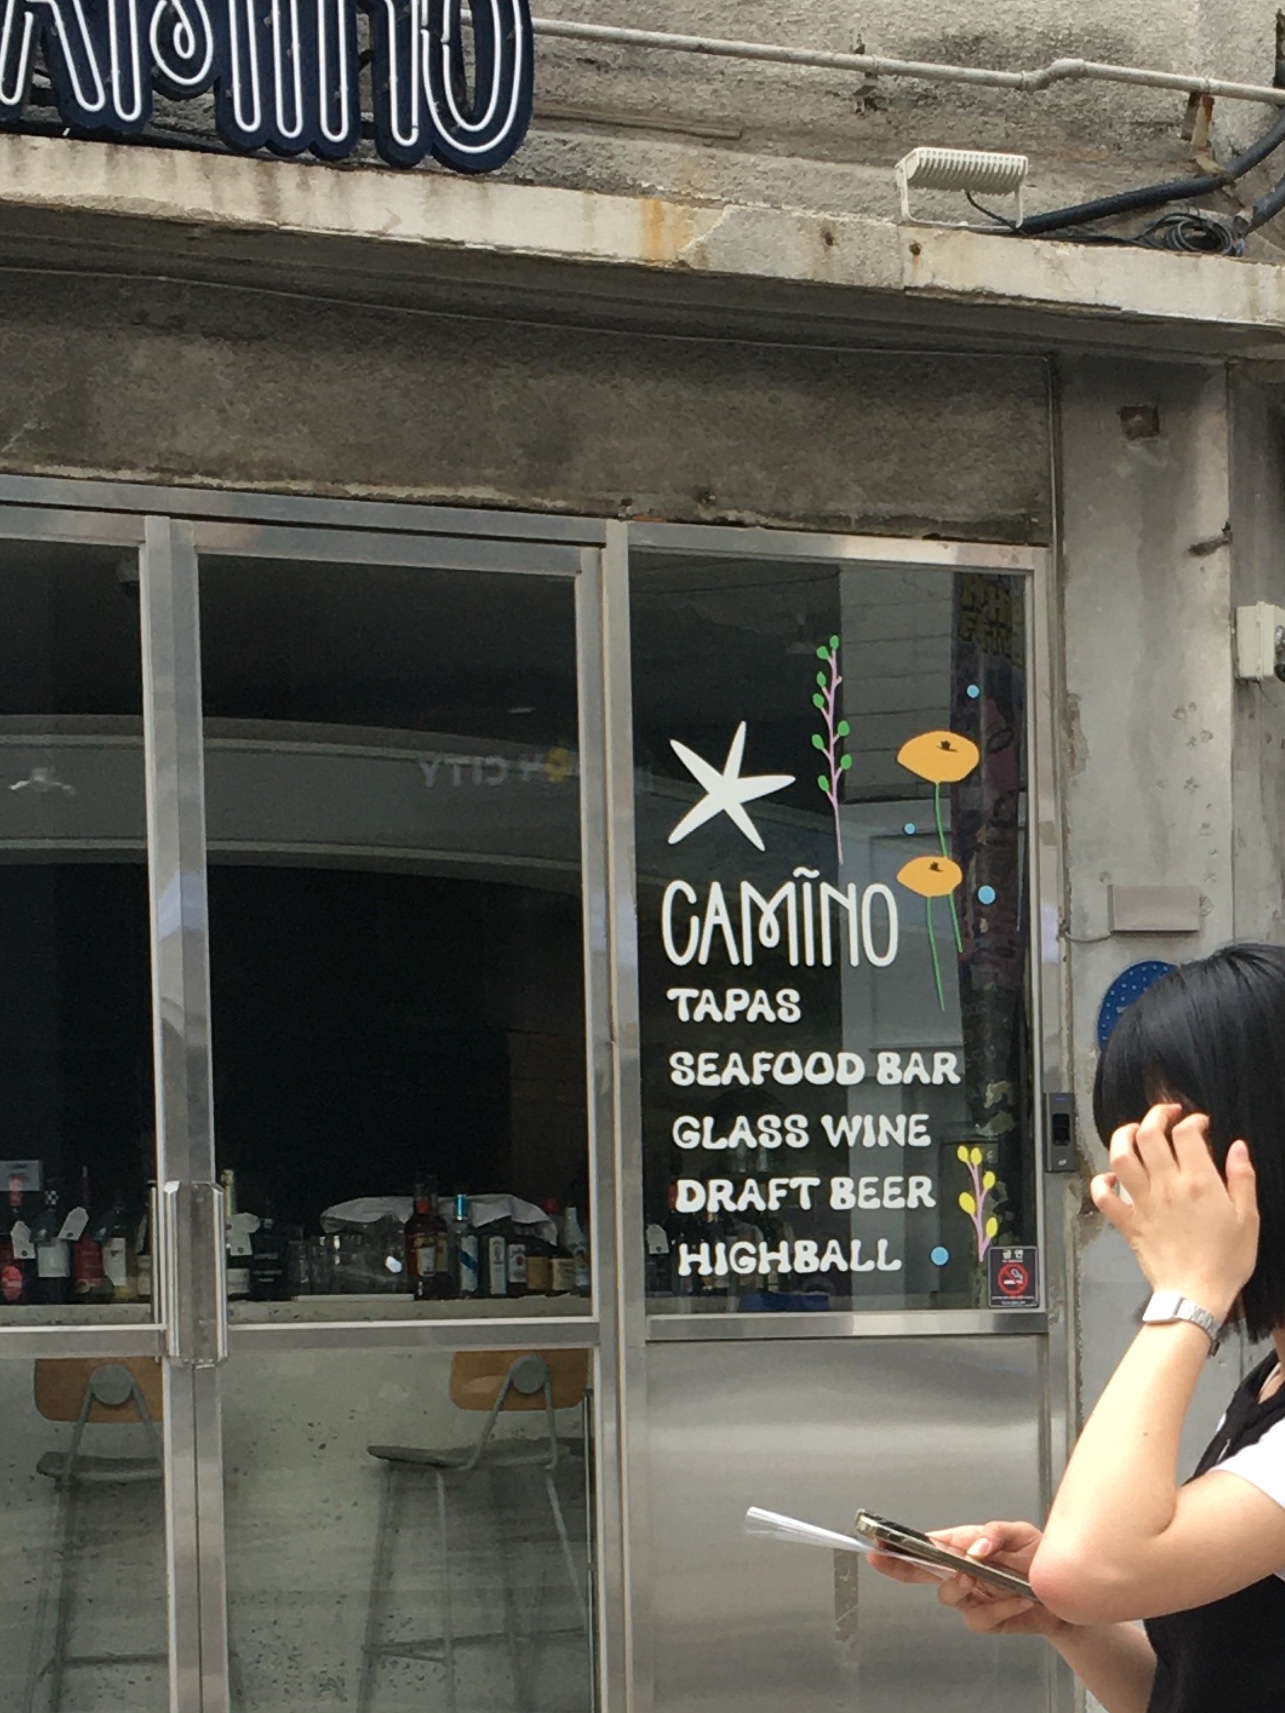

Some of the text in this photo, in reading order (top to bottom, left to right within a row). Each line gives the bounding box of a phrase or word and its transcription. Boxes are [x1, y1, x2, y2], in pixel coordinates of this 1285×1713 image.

[667, 989, 800, 1022] TAPAS
[670, 1051, 960, 1085] SEAFOOD BAR
[673, 1114, 931, 1149] GLASS WINE
[676, 1176, 936, 1212] DRAFT BEER
[679, 1239, 902, 1276] HIGHBALL
